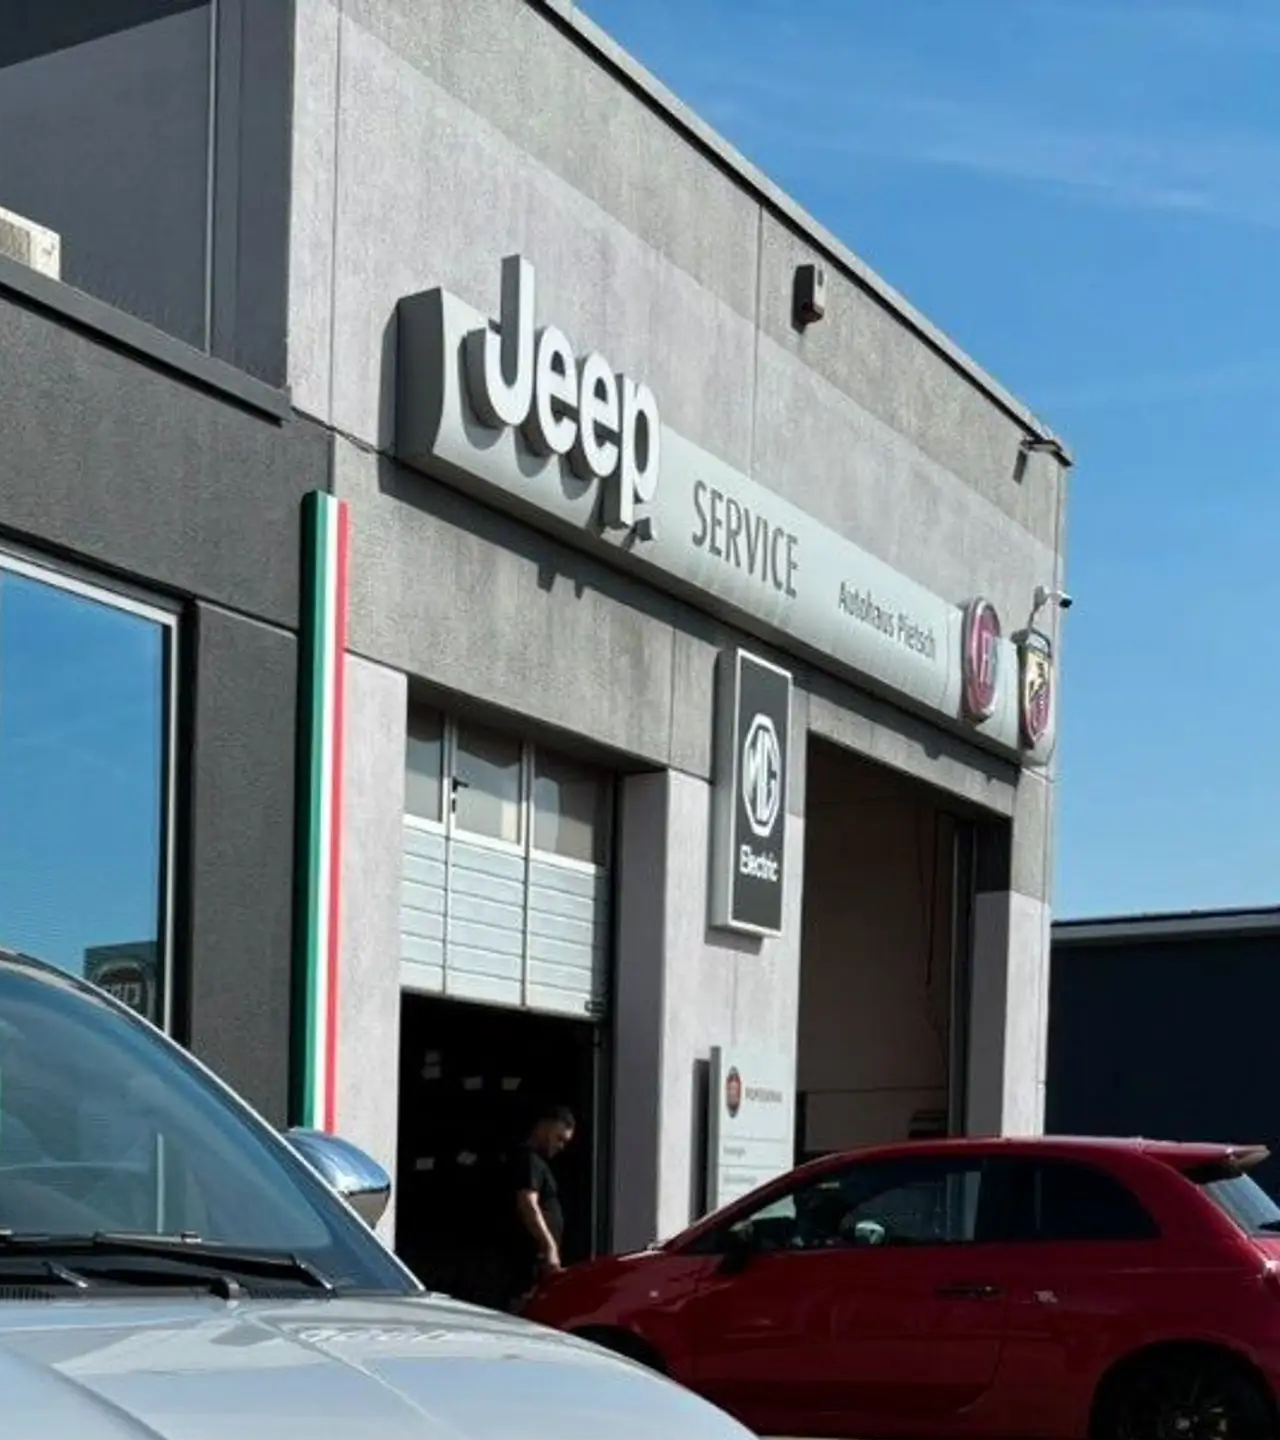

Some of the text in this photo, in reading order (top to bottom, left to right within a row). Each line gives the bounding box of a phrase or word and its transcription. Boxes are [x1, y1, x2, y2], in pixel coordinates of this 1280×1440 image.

[484, 253, 661, 530] Jeep
[690, 478, 801, 599] SERVICE
[838, 580, 895, 639] Autohaus
[740, 844, 780, 882] Electric
